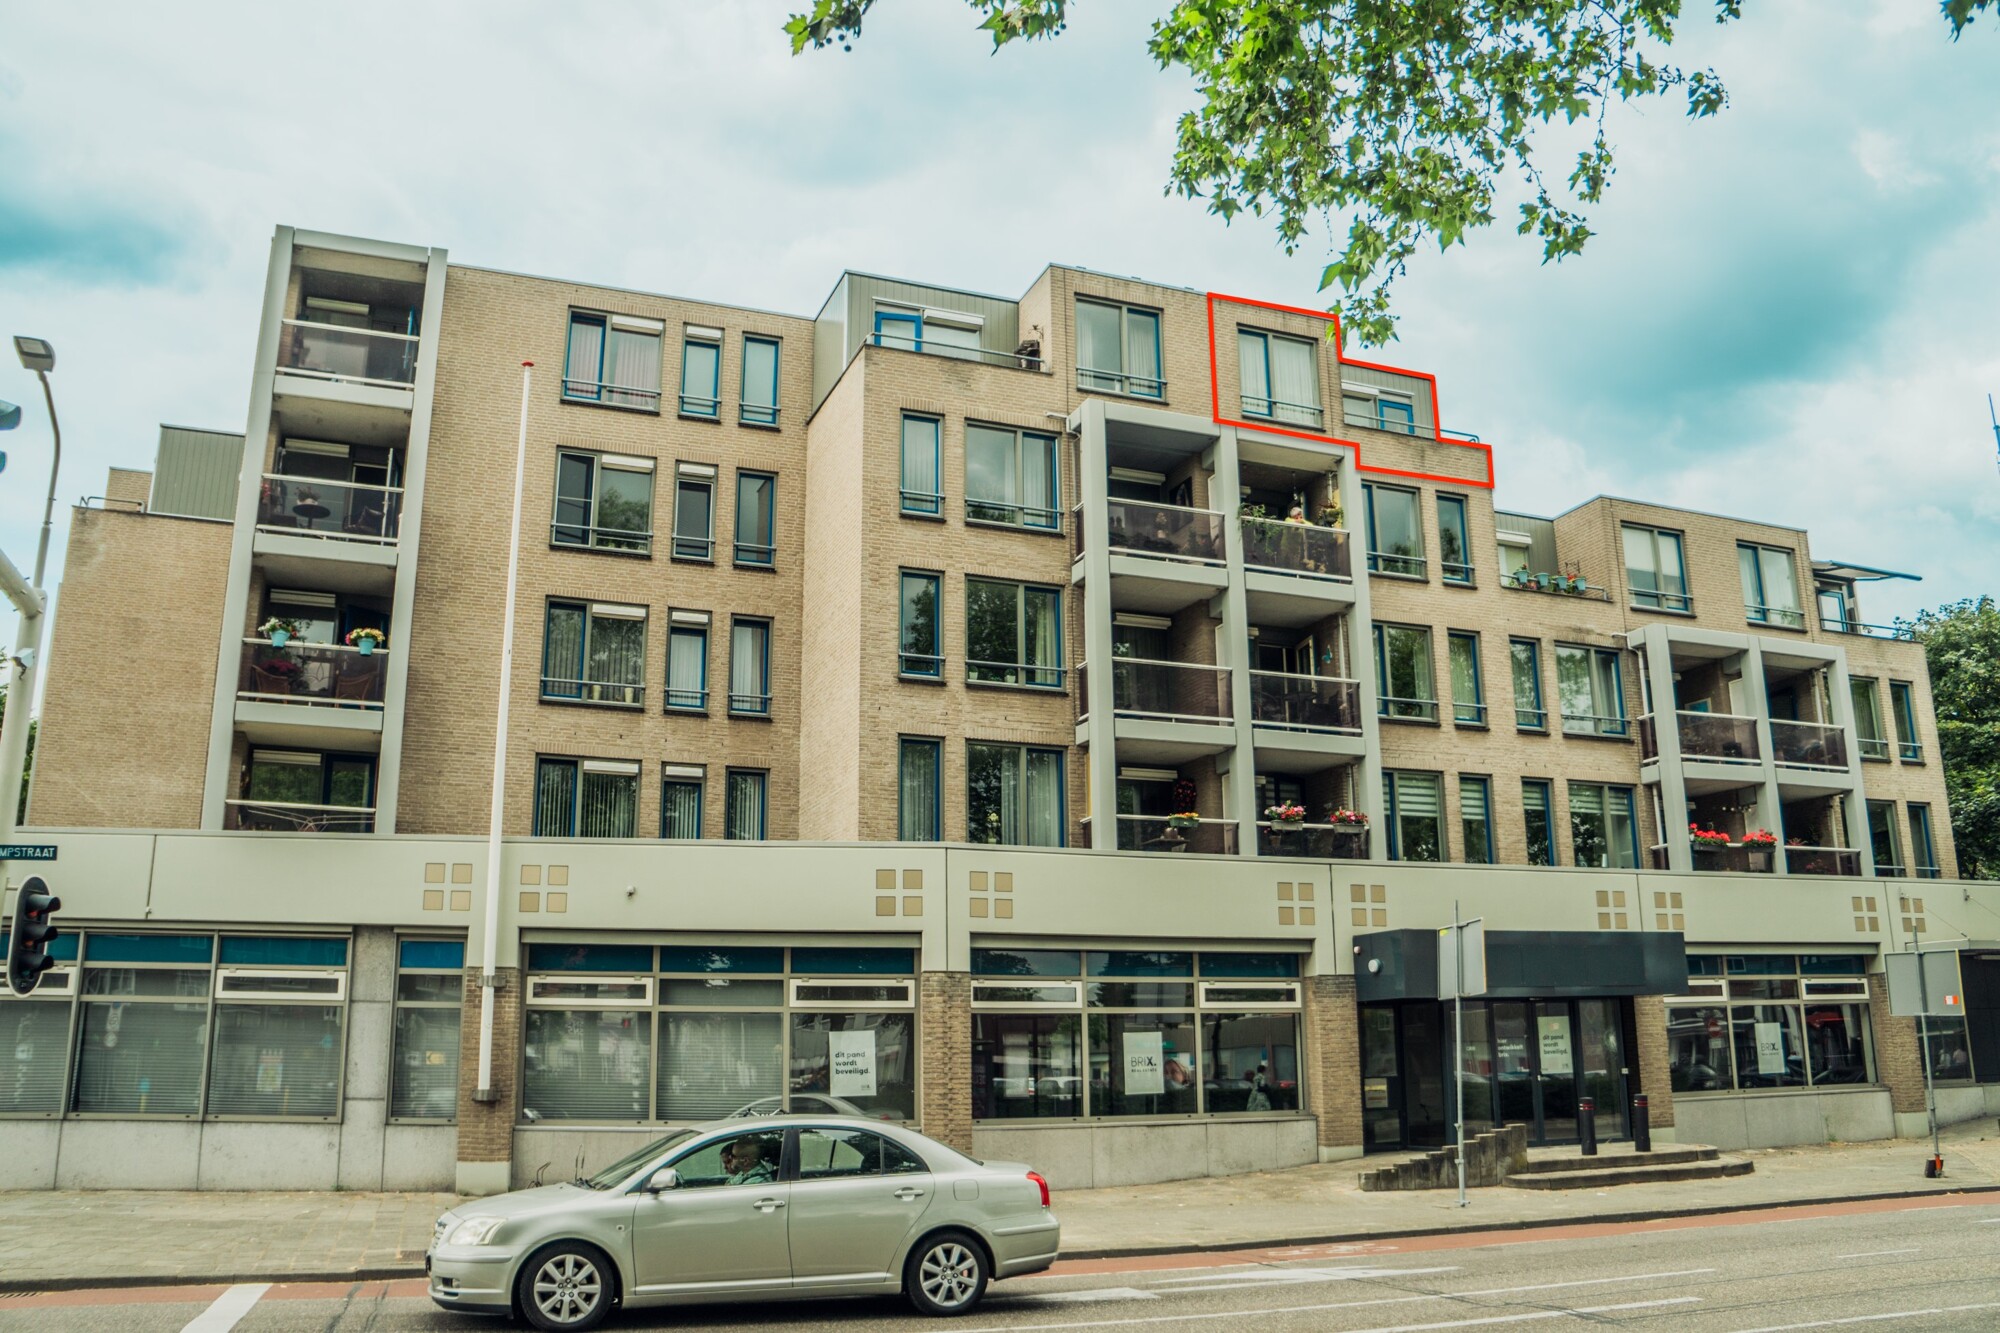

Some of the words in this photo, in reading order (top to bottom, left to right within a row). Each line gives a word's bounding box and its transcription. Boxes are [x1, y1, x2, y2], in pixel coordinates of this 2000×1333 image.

[0, 847, 55, 858] MPSTRAAT
[846, 1051, 866, 1060] pand
[835, 1068, 871, 1076] beveiligd.
